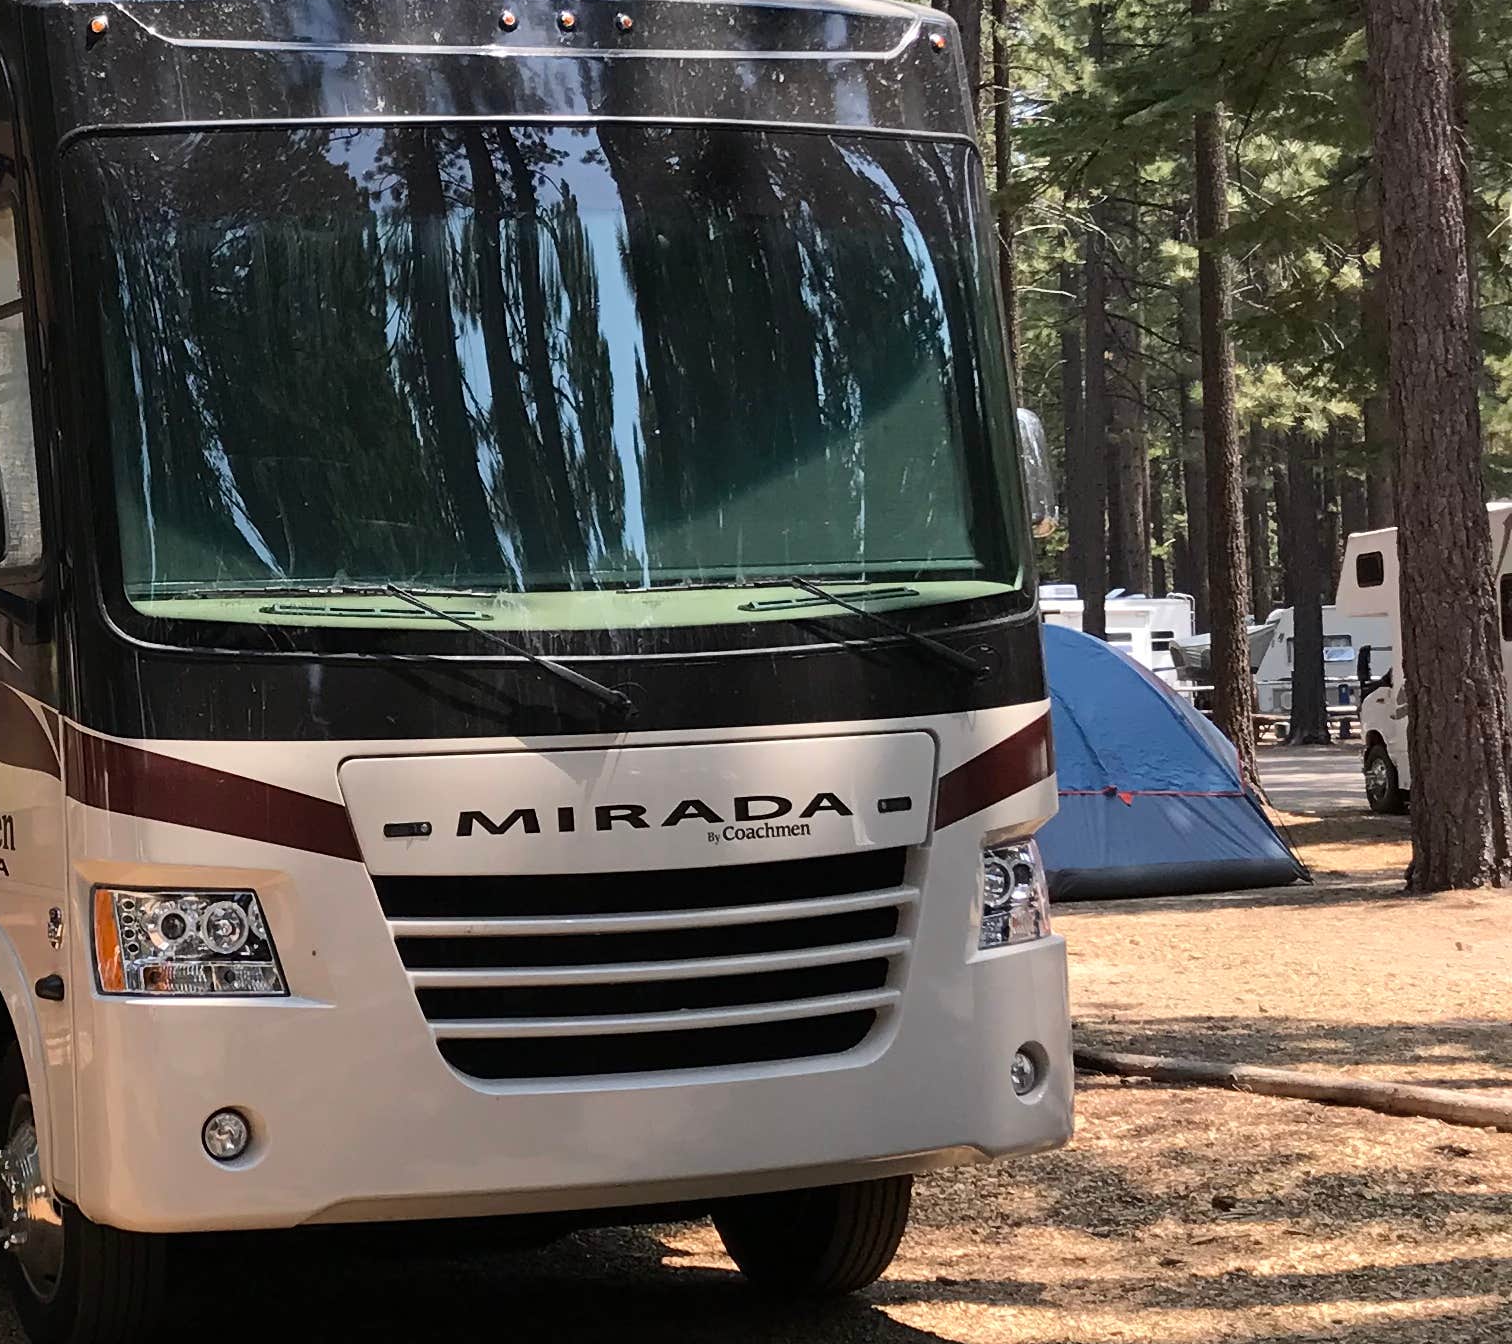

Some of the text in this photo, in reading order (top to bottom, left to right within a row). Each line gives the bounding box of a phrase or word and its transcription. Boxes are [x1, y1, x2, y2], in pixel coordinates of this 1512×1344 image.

[455, 792, 854, 837] MIRADA
[707, 822, 811, 846] By Coachmen
